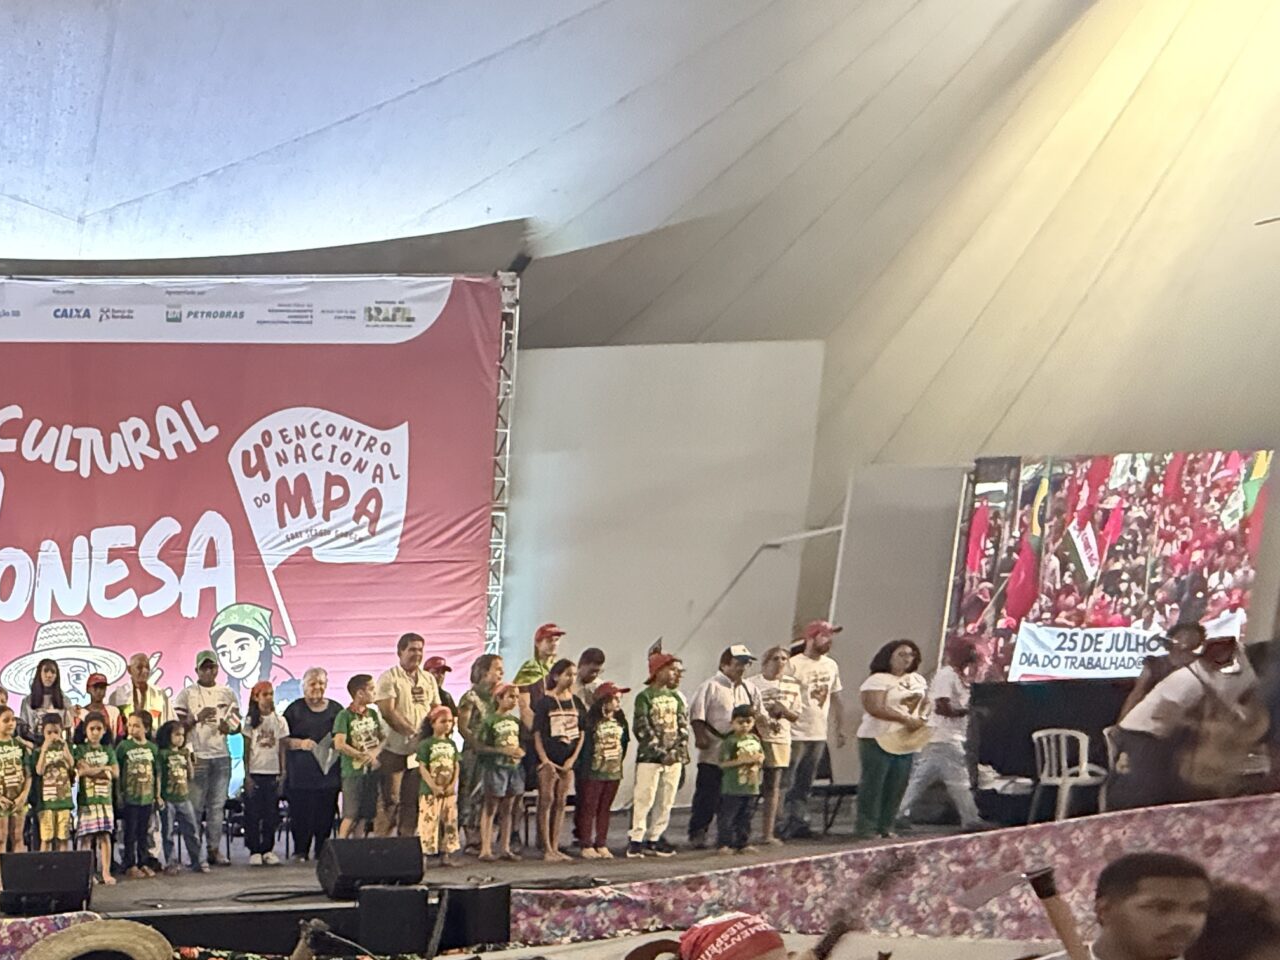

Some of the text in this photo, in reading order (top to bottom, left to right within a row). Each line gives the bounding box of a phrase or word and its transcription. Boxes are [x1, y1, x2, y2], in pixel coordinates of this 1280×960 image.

[52, 308, 92, 319] CAIXA
[186, 310, 245, 320] PETROBRAS
[278, 420, 392, 456] ENCONTRO
[275, 443, 401, 484] NACIONAL
[253, 471, 384, 537] DO MPA
[1054, 632, 1161, 653] 25 DE JULHO
[1018, 652, 1040, 666] DIA
[1041, 654, 1060, 668] DO
